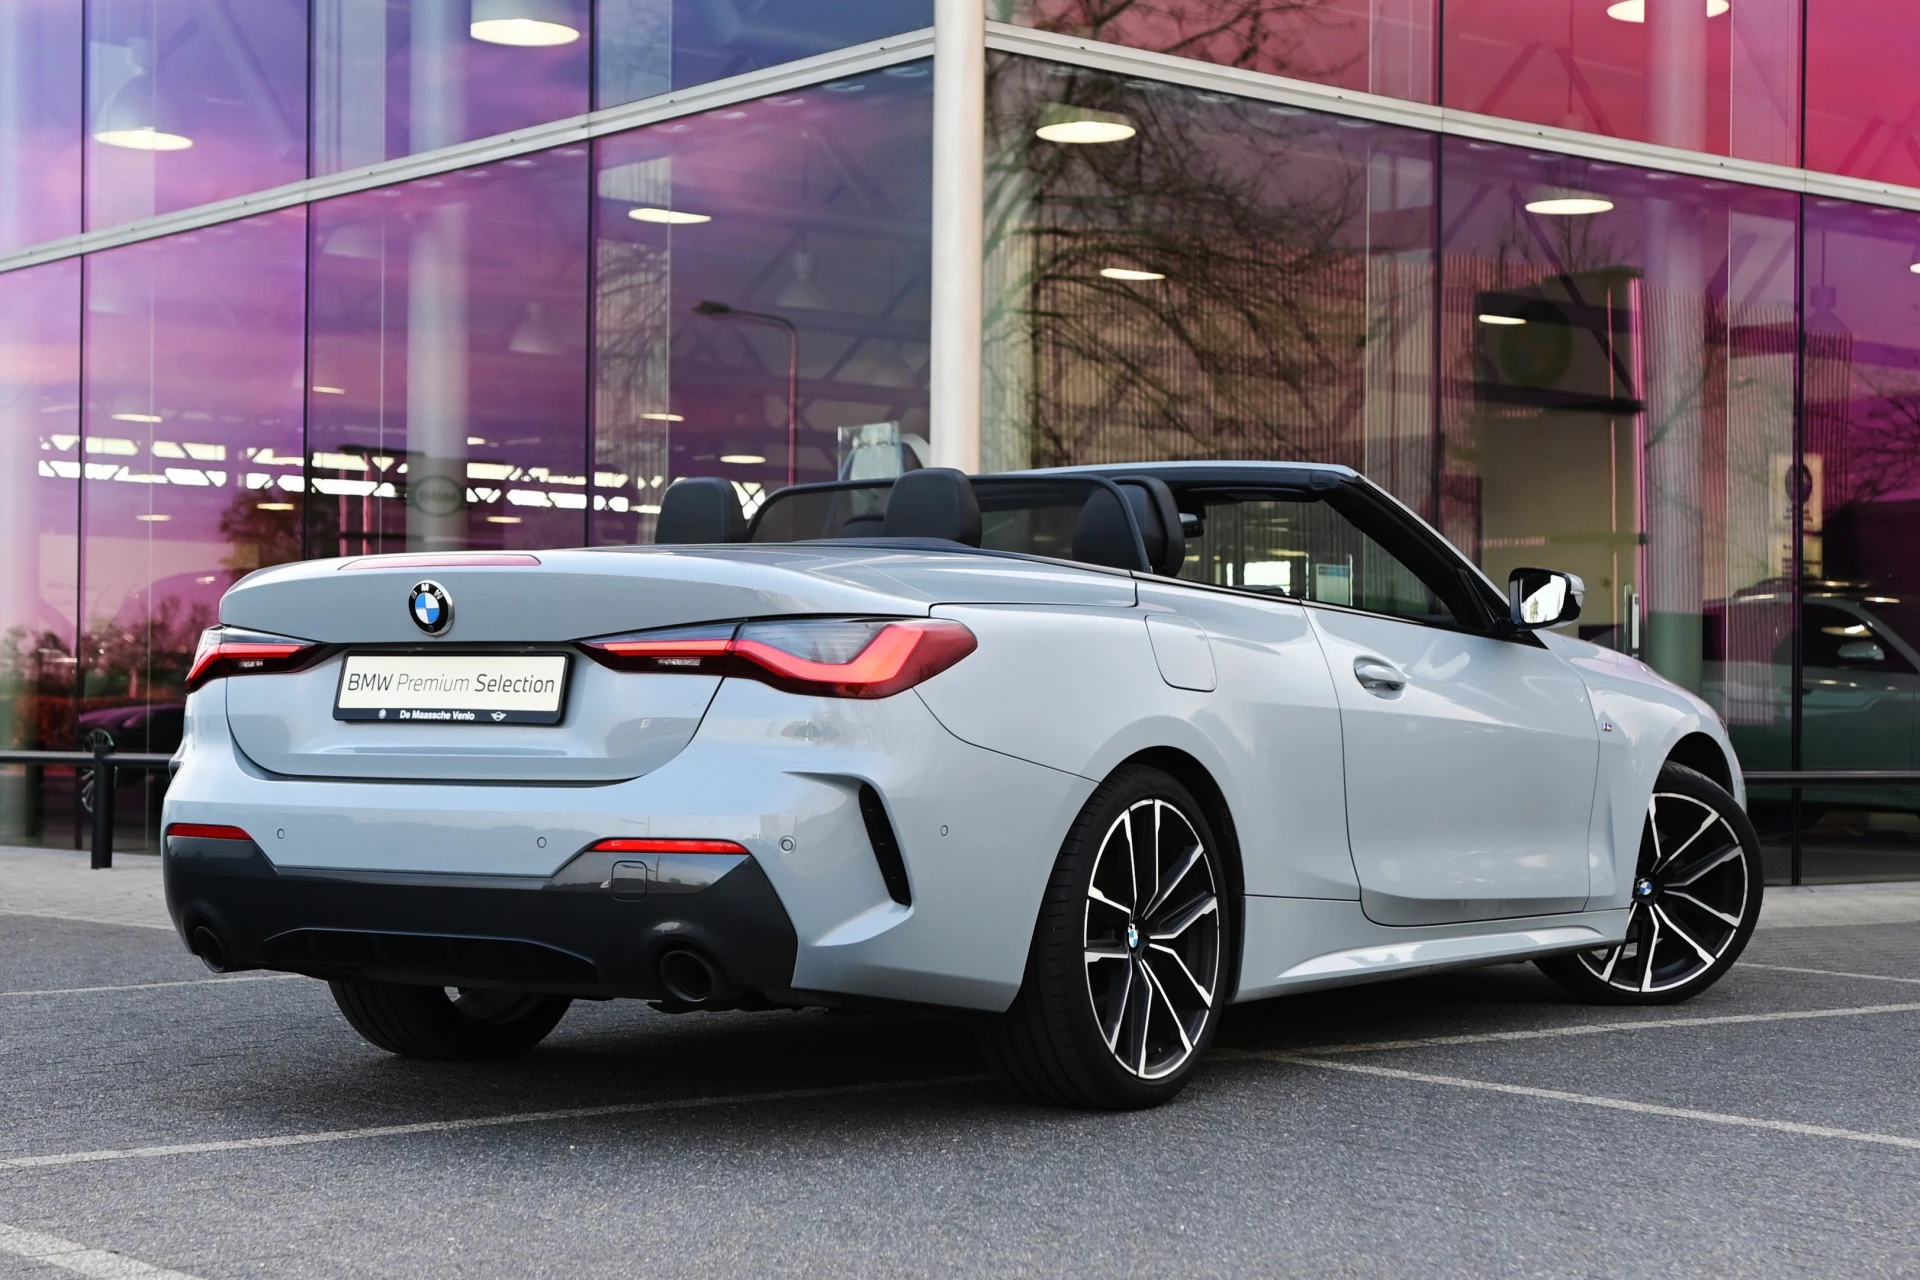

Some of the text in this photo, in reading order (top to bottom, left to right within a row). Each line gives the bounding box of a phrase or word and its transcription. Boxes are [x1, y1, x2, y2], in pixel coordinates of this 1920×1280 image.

[411, 583, 444, 600] BMW
[347, 673, 555, 694] BMW Premium Selection
[400, 709, 476, 721] De Maassche Venlo
